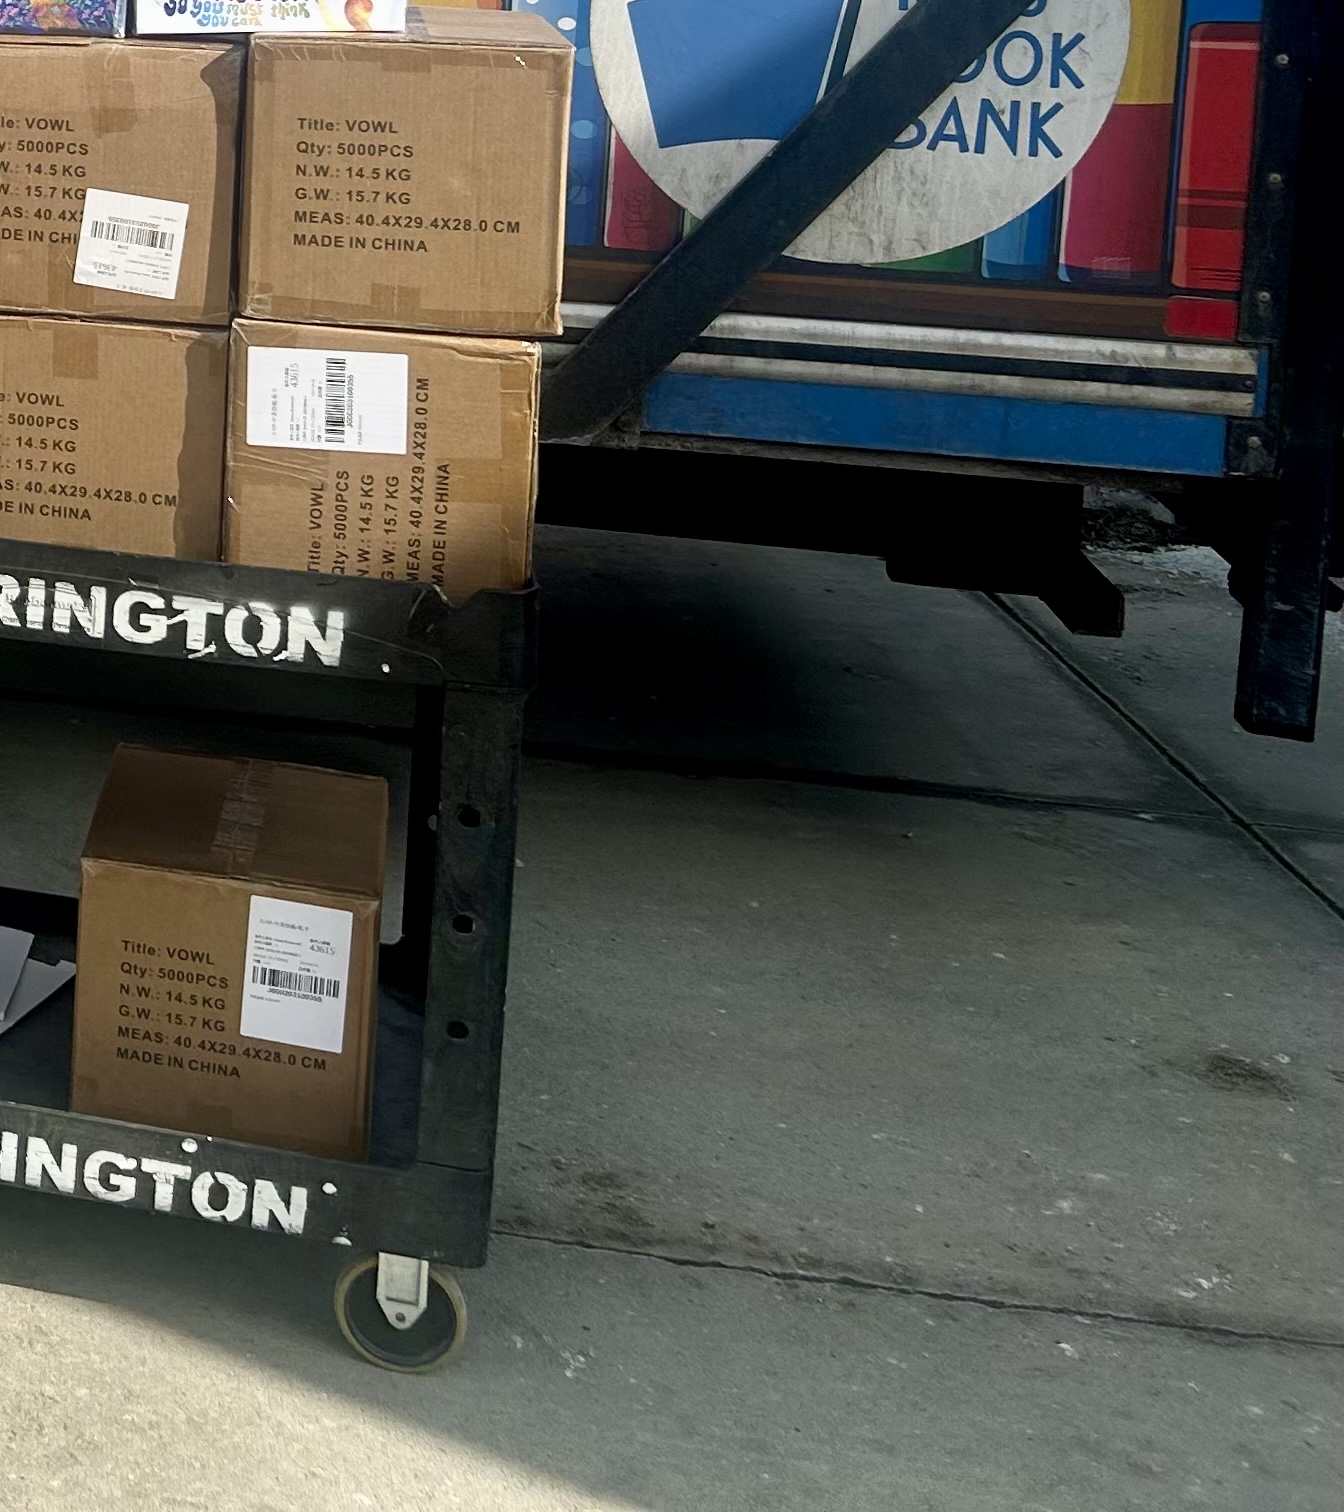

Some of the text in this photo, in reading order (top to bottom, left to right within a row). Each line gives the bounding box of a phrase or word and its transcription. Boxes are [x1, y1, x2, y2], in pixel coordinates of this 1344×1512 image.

[190, 0, 224, 18] you
[227, 3, 263, 15] must
[271, 3, 310, 20] think
[197, 14, 228, 27] you
[953, 30, 1085, 89] OK
[25, 118, 75, 132] VOWL
[297, 117, 398, 133] Title: VOWL
[17, 140, 89, 155] 5000PCS
[296, 141, 413, 158] Qty: 5000PCS
[25, 164, 57, 176] 14.5
[62, 165, 86, 177] KG
[346, 167, 380, 180] 14.5
[386, 169, 411, 181] KG
[25, 186, 57, 198] 15.7
[62, 187, 86, 200] KG
[346, 190, 380, 203] 15.7
[386, 192, 411, 205] KG
[34, 208, 83, 223] 40.4X
[294, 211, 520, 233] MEAS: 40.4X29.4X28.0 CM
[28, 230, 44, 242] IN
[49, 231, 78, 244] CHI
[293, 234, 428, 253] MADE IN CHINA
[16, 392, 64, 407] VOWL
[416, 378, 430, 403] CM
[8, 413, 79, 431] 5000PCS
[16, 436, 47, 450] 14.5
[52, 439, 76, 452] KG
[16, 459, 47, 471] 15.7
[52, 461, 76, 475] KG
[409, 407, 428, 528] 40.4X29.4X28.0
[24, 481, 147, 504] 40.4X29.4X28.0
[152, 494, 177, 507] CM
[361, 474, 374, 498] KG
[386, 475, 400, 501] KG
[19, 502, 34, 515] IN
[40, 504, 91, 521] CHINA
[358, 502, 373, 534] 14.5
[384, 503, 398, 535] 15.7
[307, 484, 324, 573] Title: VOWL
[332, 470, 350, 575] Qty: 5000PCS
[432, 463, 451, 587] MADE IN CHINA
[121, 940, 215, 965] Title: VOWL
[121, 962, 229, 989] Qty: 5000PCS
[166, 991, 197, 1005] 14.5
[202, 997, 226, 1010] KG
[166, 1012, 197, 1027] 15.7
[202, 1018, 225, 1032] KG
[117, 1026, 326, 1071] MEAS: 40.4X29.4X28.0 CM
[117, 1047, 240, 1078] MADE IN CHINA
